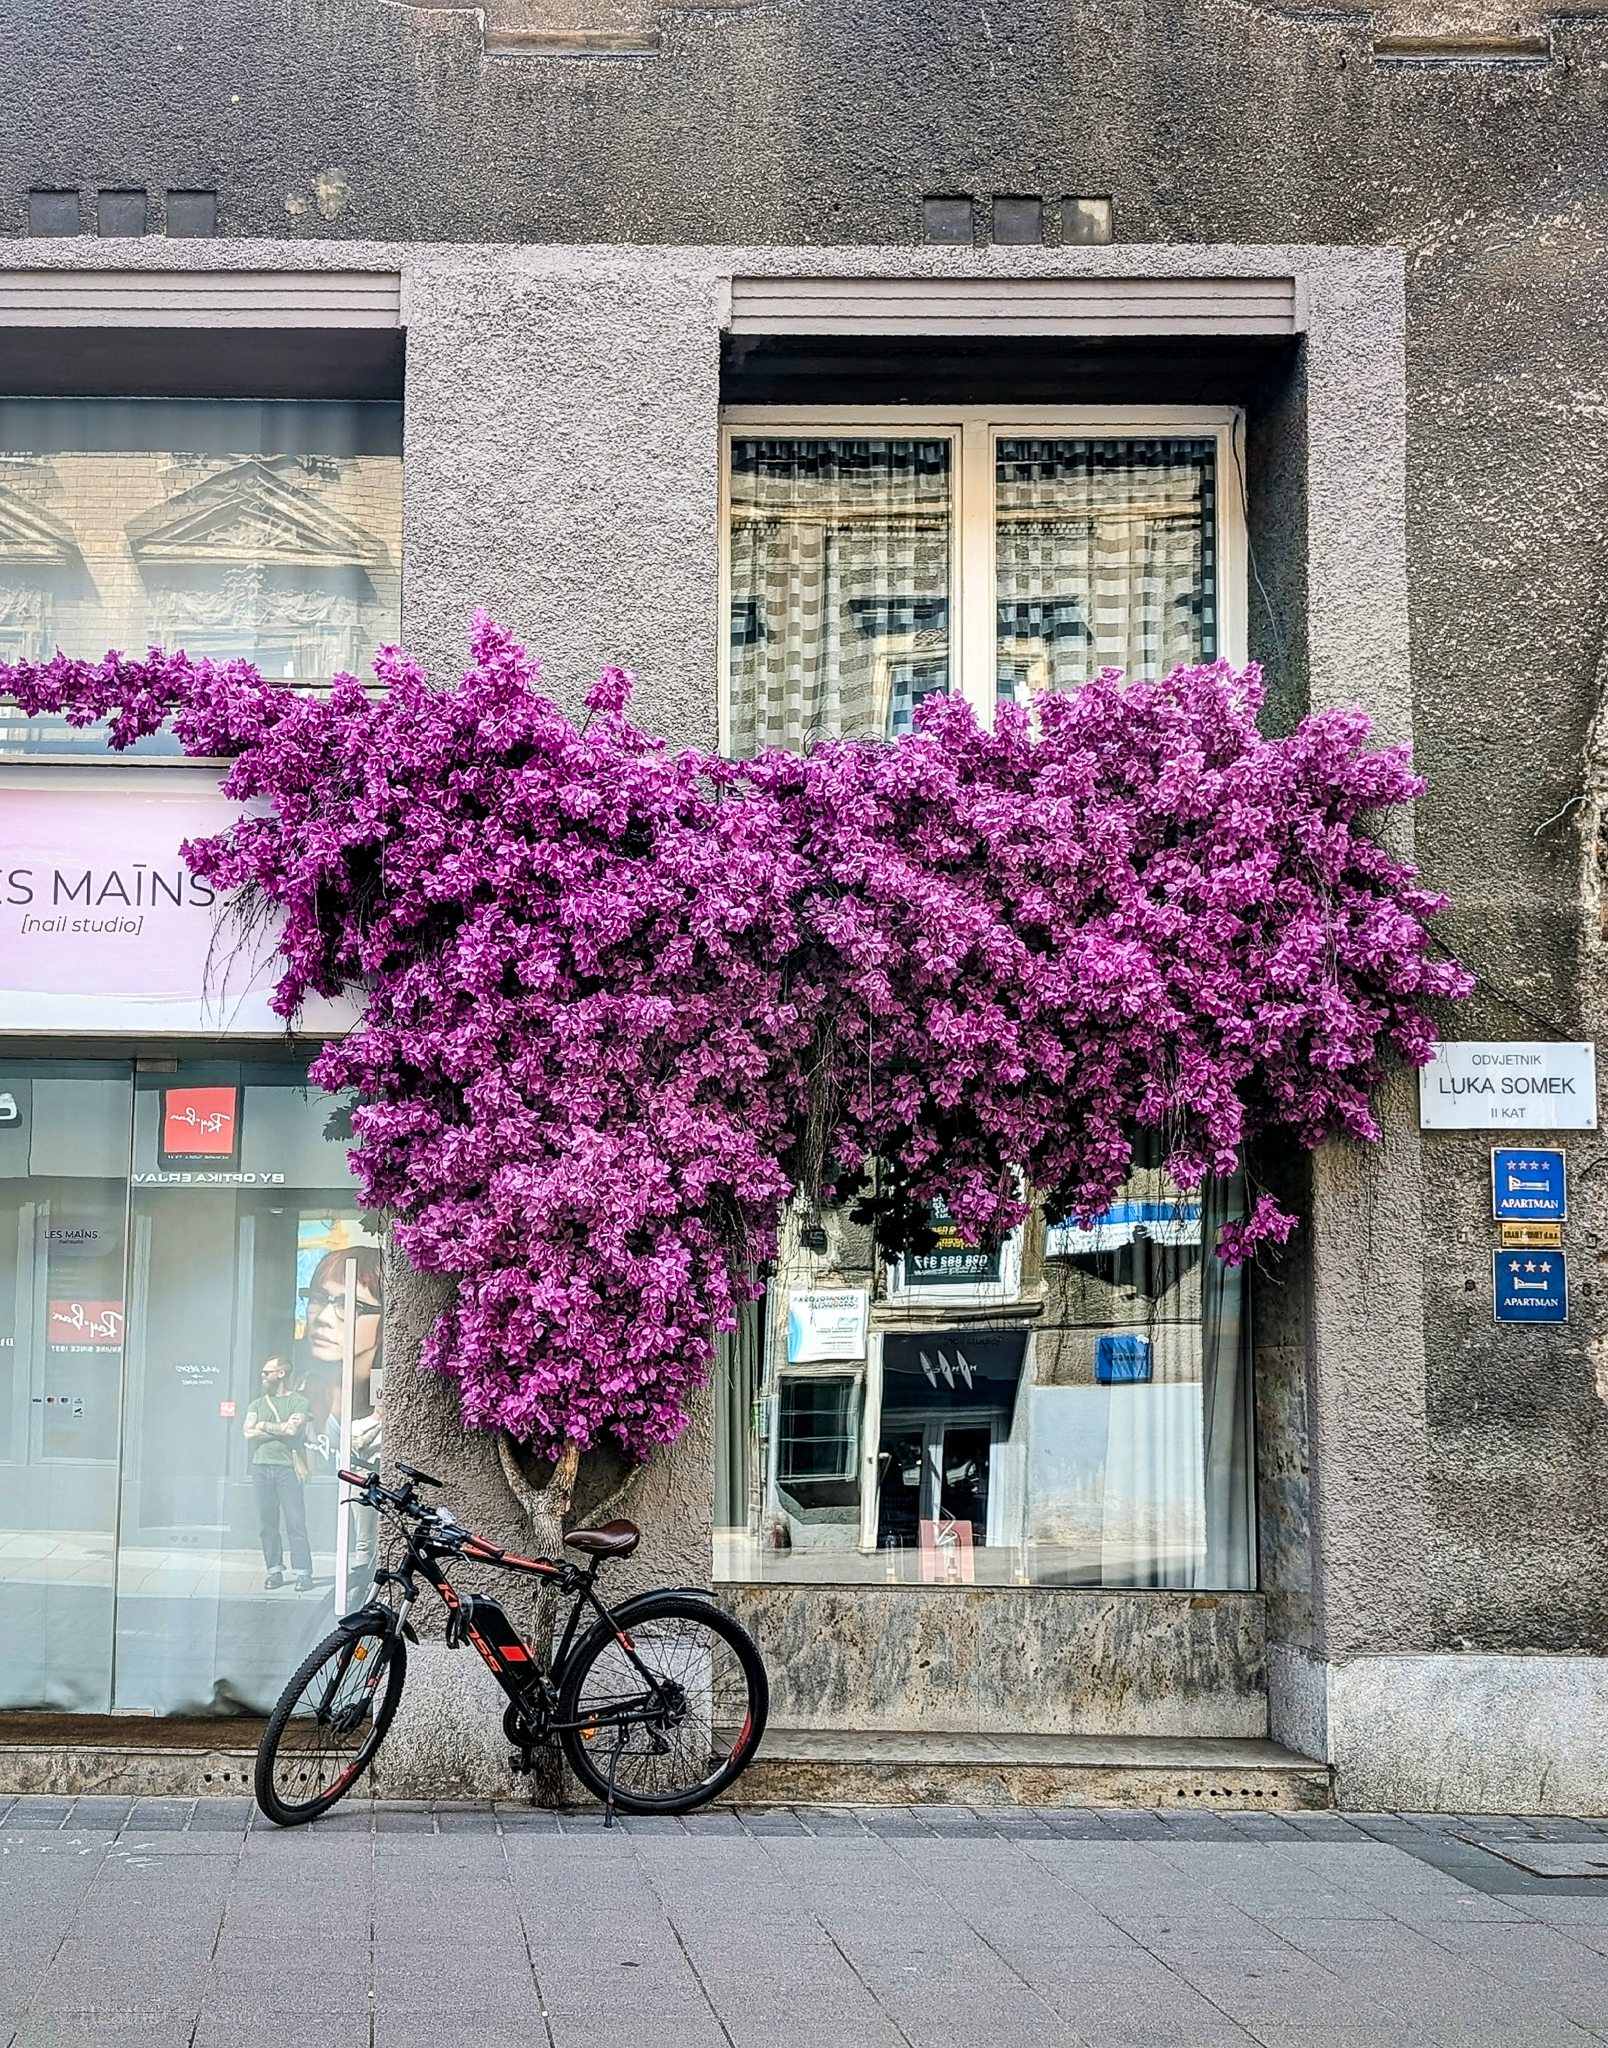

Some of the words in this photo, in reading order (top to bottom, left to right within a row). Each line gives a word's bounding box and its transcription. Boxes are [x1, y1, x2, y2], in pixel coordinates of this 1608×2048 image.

[0, 869, 35, 905] S
[21, 914, 67, 935] [nail
[72, 914, 144, 936] studio]
[1471, 1054, 1542, 1066] ODVJETNIK
[1439, 1077, 1495, 1095] LUKA
[1501, 1077, 1576, 1095] SOMEK
[1490, 1107, 1498, 1119] II
[1501, 1107, 1526, 1119] KAT
[1500, 1198, 1559, 1210] APARTMAN
[44, 1230, 63, 1240] LES
[1503, 1297, 1559, 1308] APARTMAN
